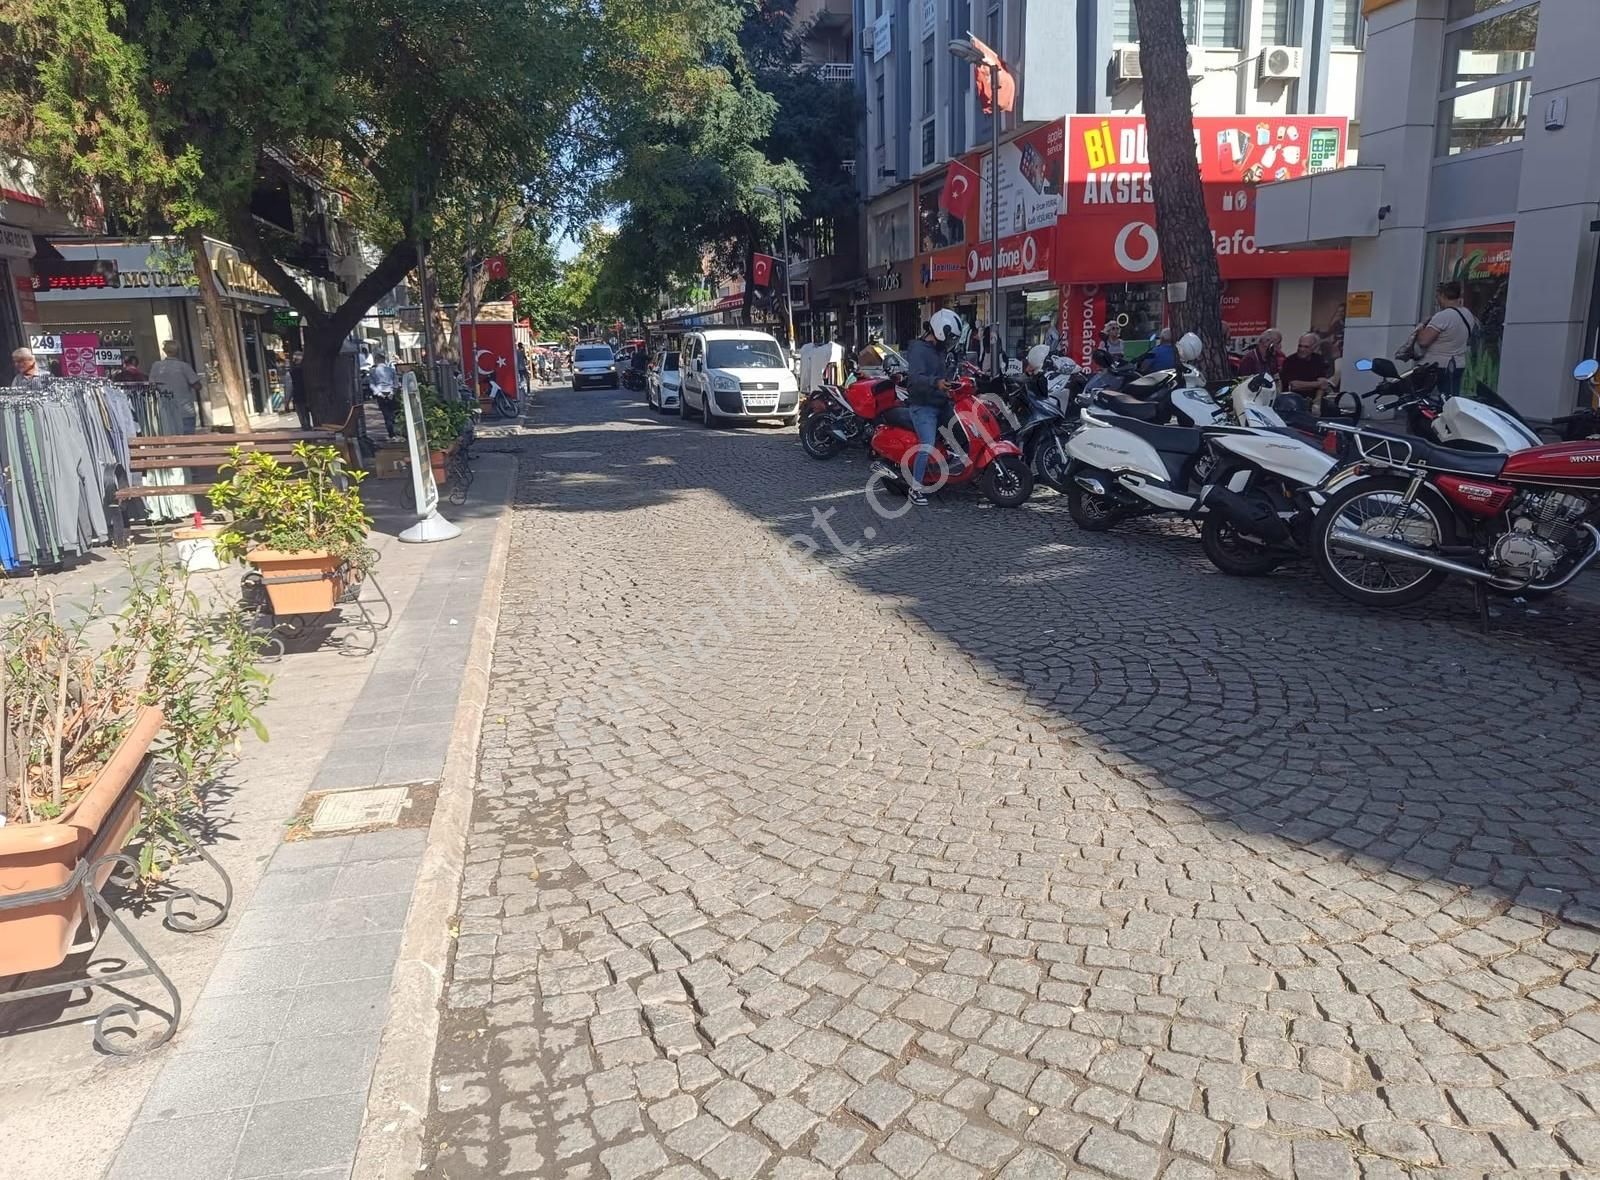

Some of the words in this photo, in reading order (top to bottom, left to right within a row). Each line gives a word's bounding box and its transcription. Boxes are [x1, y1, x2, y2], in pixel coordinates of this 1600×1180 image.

[1047, 128, 1063, 145] apple
[1083, 120, 1117, 170] Bİ
[1083, 172, 1156, 204] AKSES
[1082, 297, 1096, 375] vodafone
